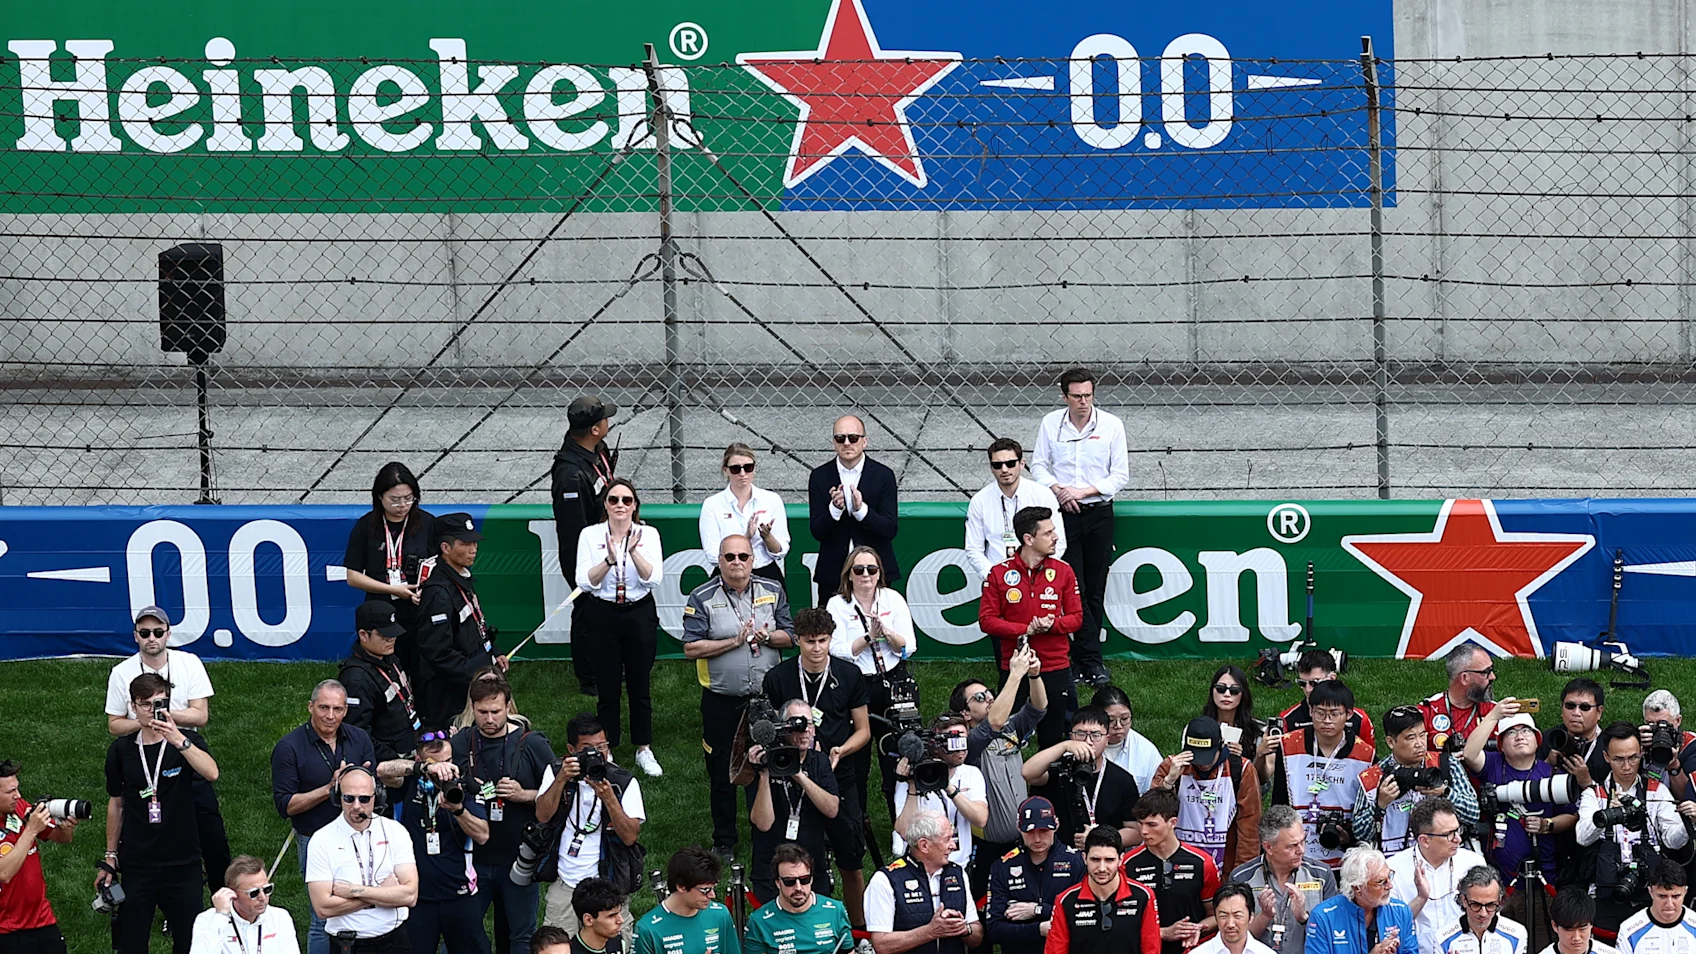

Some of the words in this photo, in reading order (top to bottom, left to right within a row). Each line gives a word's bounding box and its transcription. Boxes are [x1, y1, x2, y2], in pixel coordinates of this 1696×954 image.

[7, 36, 703, 153] Heineken
[1069, 33, 1234, 149] 0.0
[126, 519, 313, 648] 0.0
